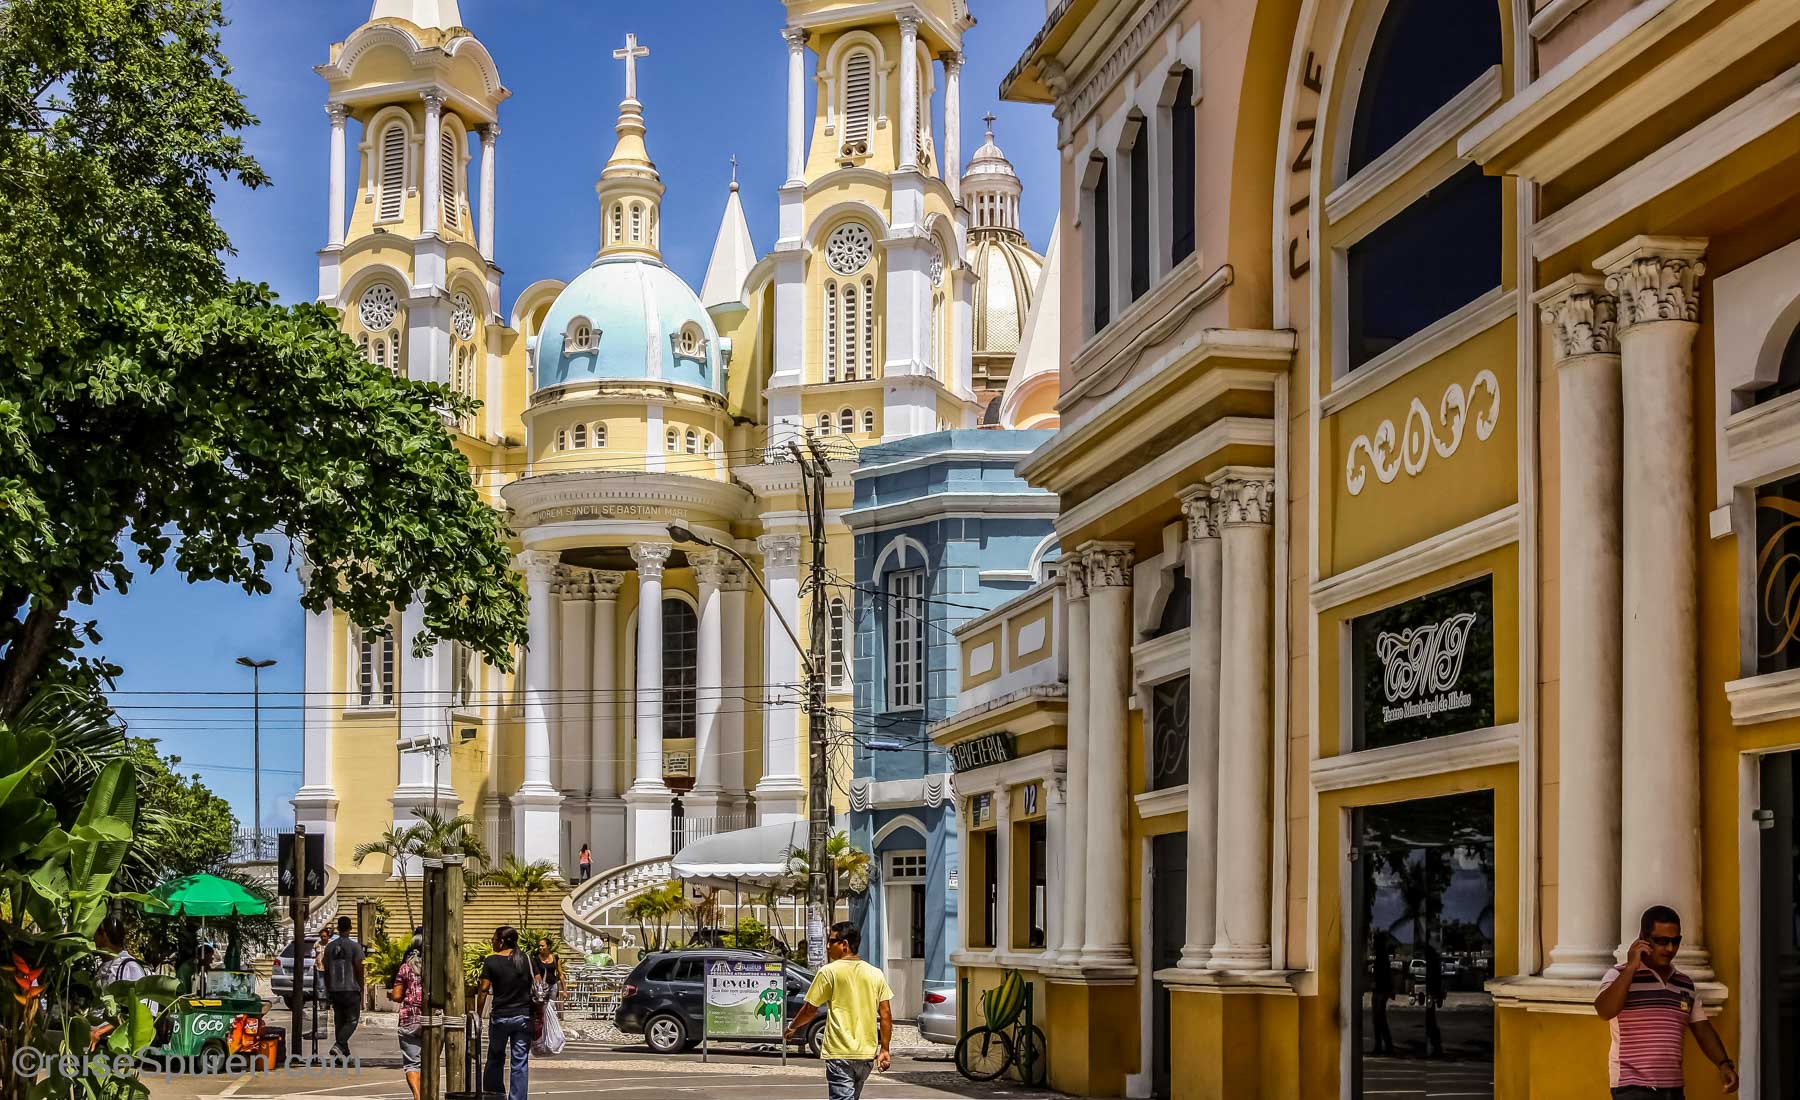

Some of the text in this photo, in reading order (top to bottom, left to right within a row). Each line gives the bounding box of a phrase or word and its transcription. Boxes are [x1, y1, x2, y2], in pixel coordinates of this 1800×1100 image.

[602, 505, 661, 516] SEBASTIANI
[1382, 690, 1472, 723] Teatro Municipal de Ilhéus
[946, 735, 1008, 771] SORVETERIA
[192, 1013, 223, 1035] Coco
